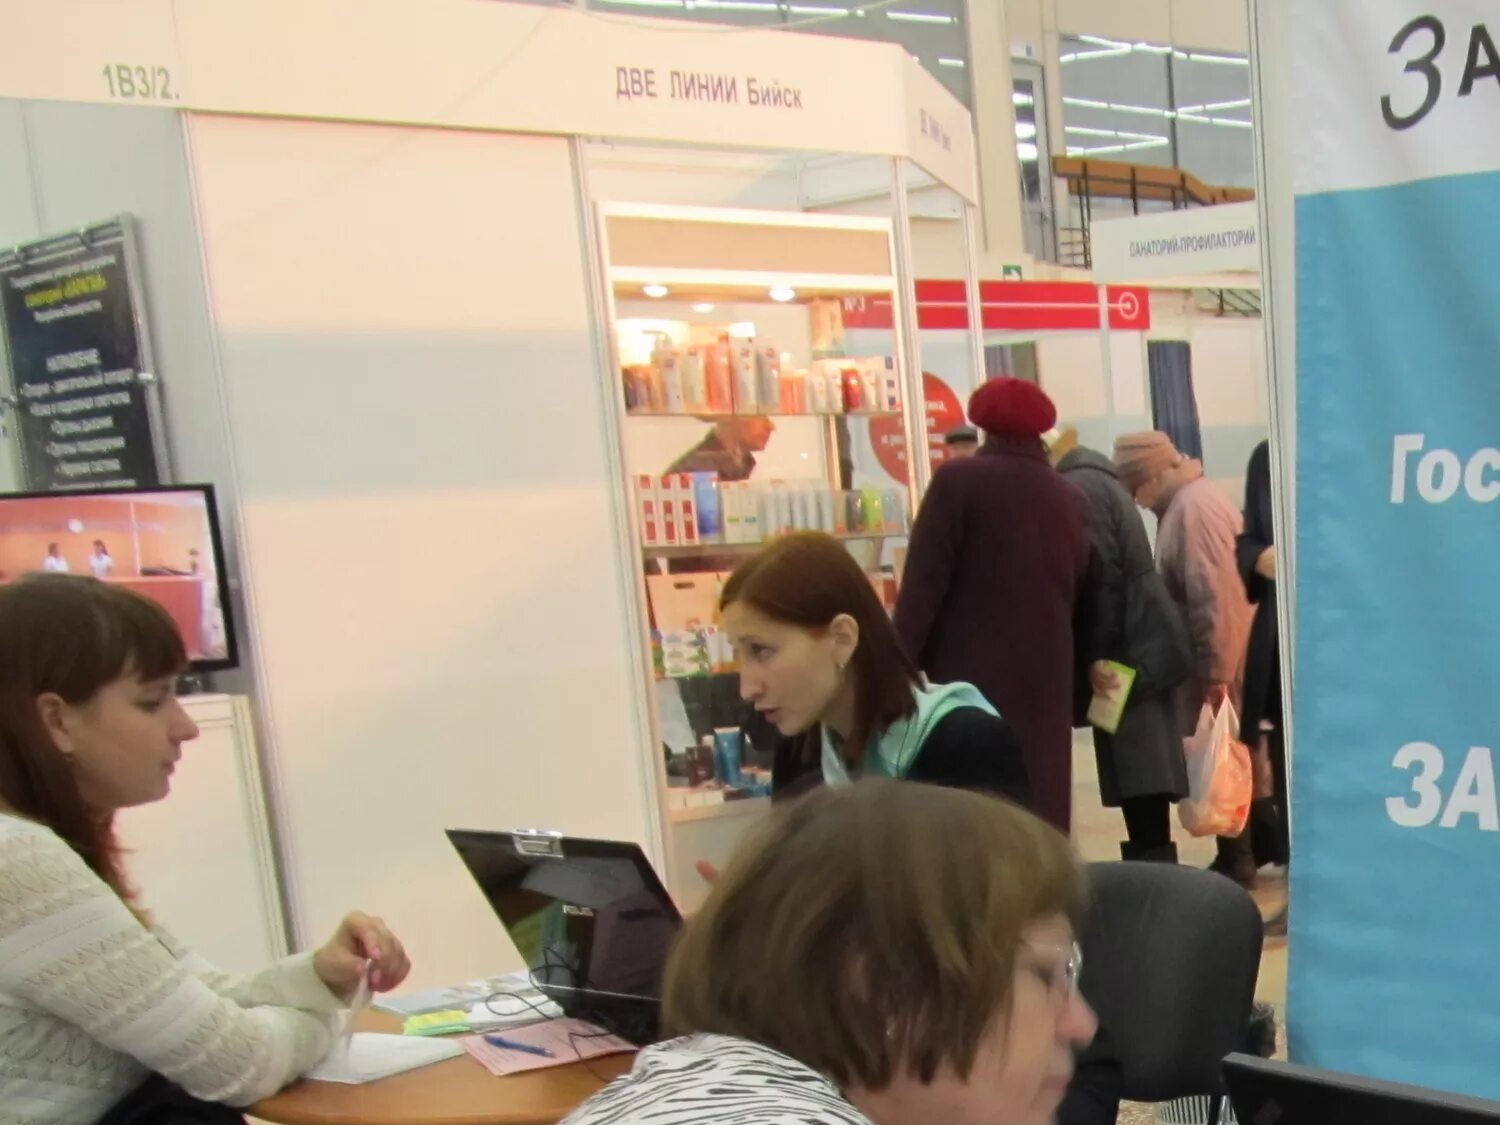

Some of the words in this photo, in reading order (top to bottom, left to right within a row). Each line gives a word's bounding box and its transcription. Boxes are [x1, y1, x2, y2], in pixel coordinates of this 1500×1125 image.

[615, 66, 657, 101] ДВЕ
[670, 70, 738, 104] ЛИНИИ
[746, 77, 803, 109] Бийск
